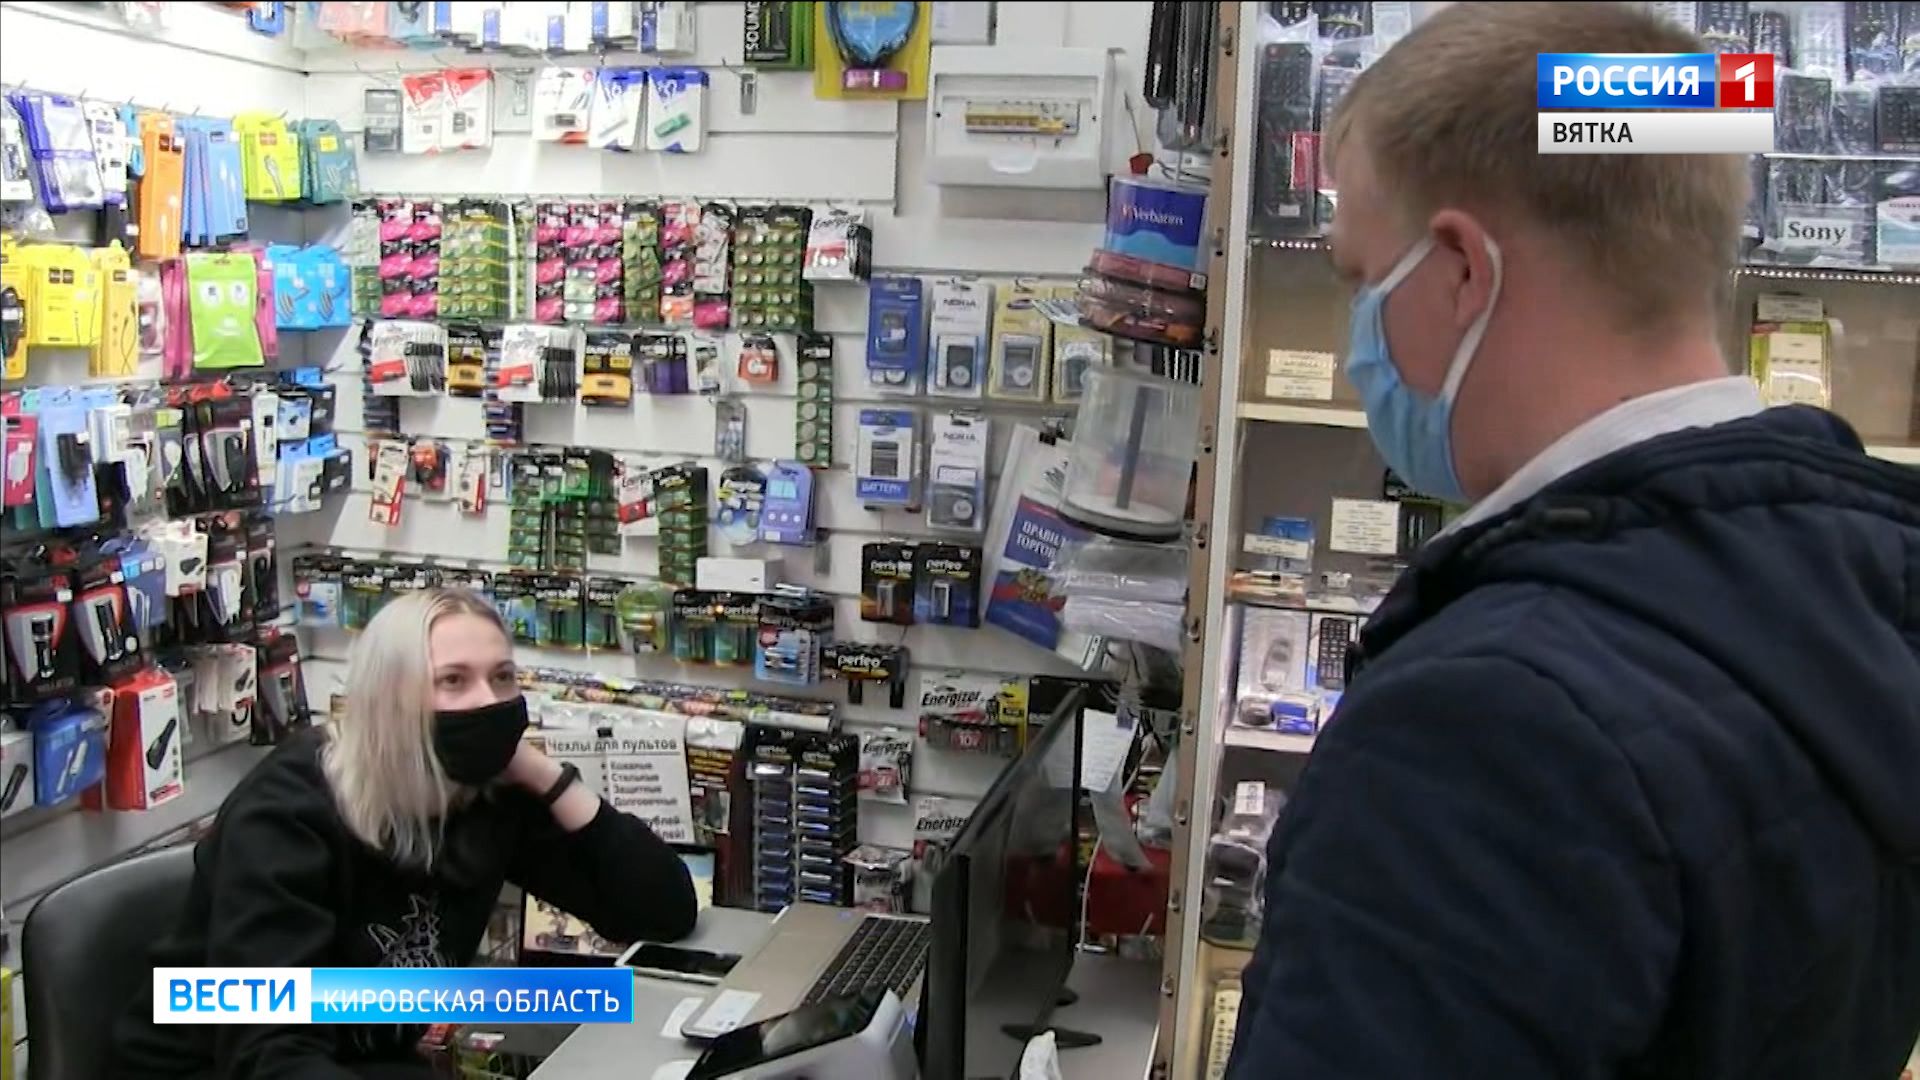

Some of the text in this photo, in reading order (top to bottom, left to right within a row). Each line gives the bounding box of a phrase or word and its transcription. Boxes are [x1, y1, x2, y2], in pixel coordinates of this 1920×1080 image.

[1788, 221, 1846, 246] Sony
[944, 298, 976, 308] NOKIA
[943, 431, 976, 442] NOKIA
[861, 483, 902, 493] BATTERY
[837, 655, 881, 669] perfeo
[921, 690, 982, 708] Energizer
[594, 739, 619, 752] для
[622, 738, 678, 754] пультов
